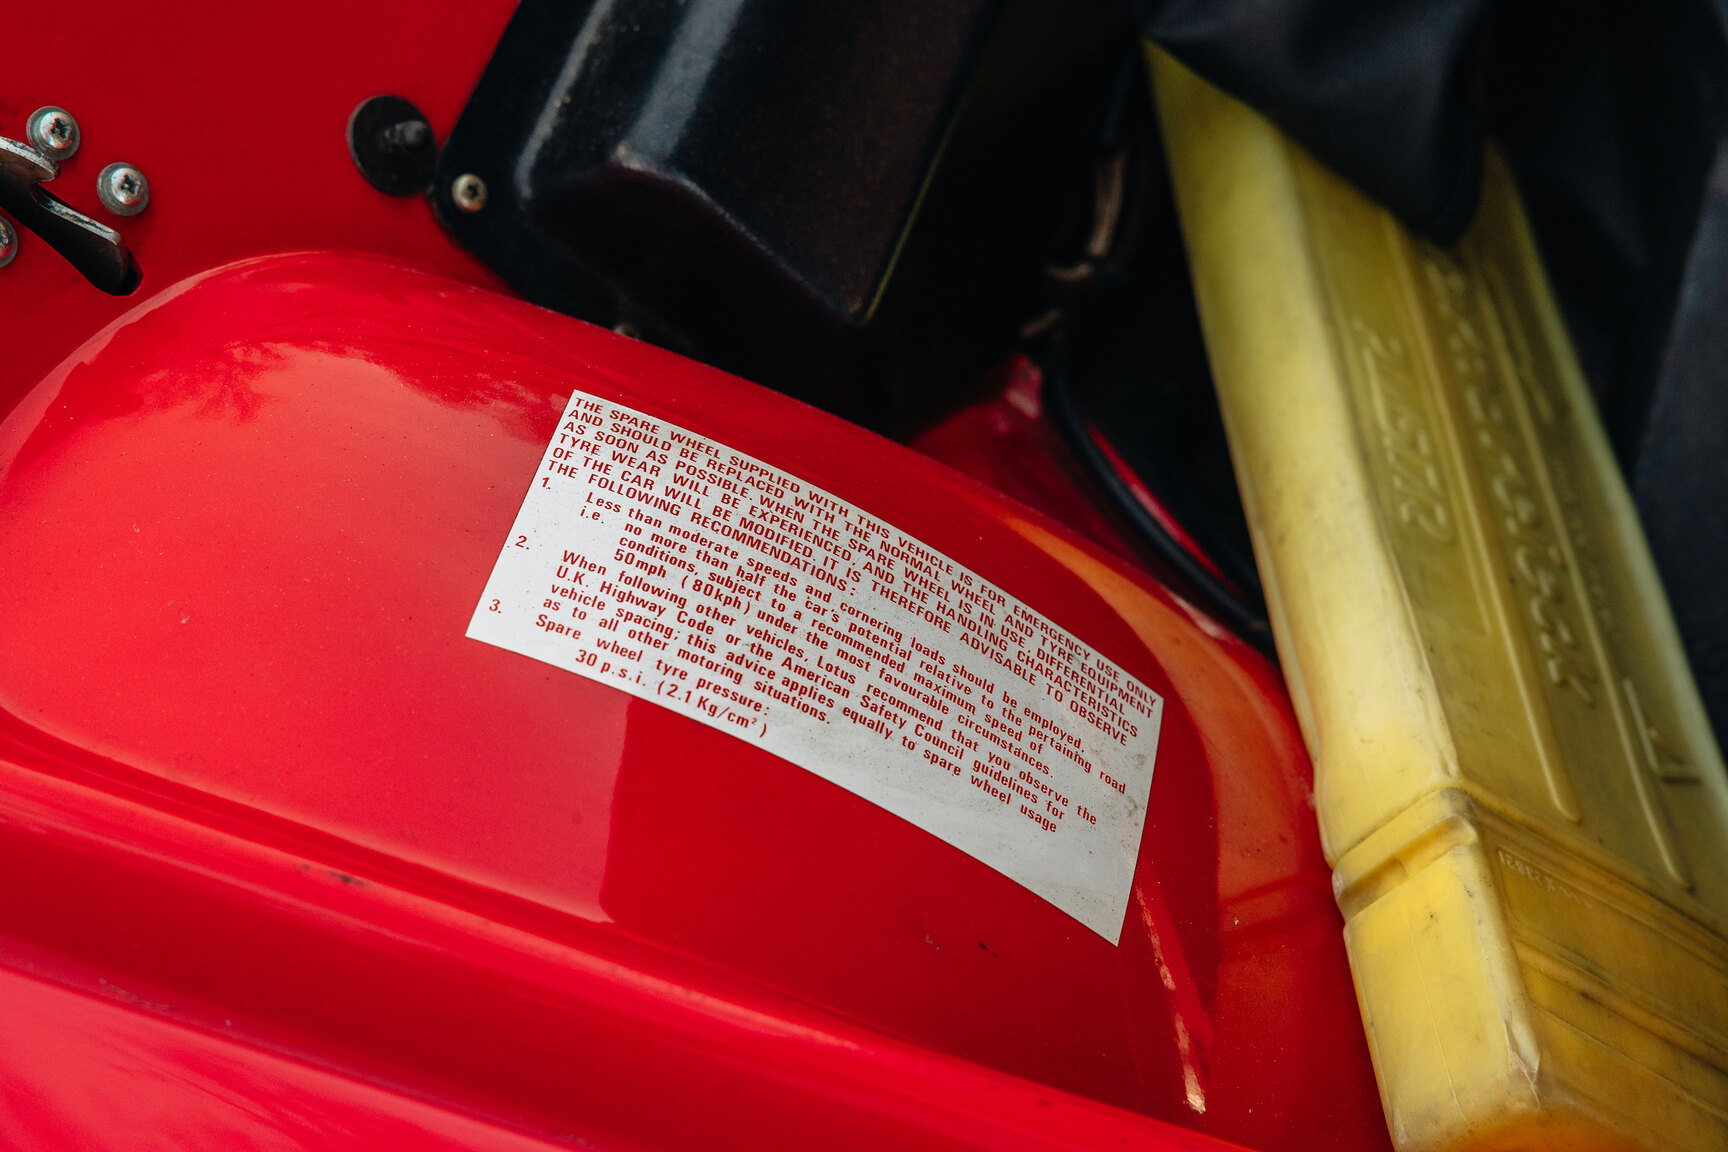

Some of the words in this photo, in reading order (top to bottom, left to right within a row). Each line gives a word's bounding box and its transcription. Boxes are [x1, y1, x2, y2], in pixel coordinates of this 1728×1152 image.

[488, 598, 502, 614] 3.
[535, 613, 582, 640] Spare
[596, 637, 644, 663] wheel
[655, 658, 689, 681] tyre
[695, 677, 770, 716] pressure:
[541, 477, 551, 490] 1.
[586, 491, 622, 513] Less
[628, 508, 663, 529] than
[668, 524, 739, 560] moderate
[746, 557, 798, 587] speeds
[804, 584, 833, 604] and
[839, 602, 904, 646] cornering
[910, 636, 946, 666] loads
[951, 663, 996, 695] should
[1002, 689, 1018, 709] be
[1023, 706, 1085, 753] employed,
[543, 598, 561, 612] as
[571, 606, 588, 621] to
[597, 617, 620, 633] all
[627, 628, 670, 652] other
[676, 647, 744, 686] motoring
[753, 680, 831, 725] situations.
[548, 459, 578, 479] THE
[587, 473, 682, 517] FOLLOWING
[689, 511, 856, 597] RECOMMENDATIONS:
[552, 447, 574, 461] OF
[583, 455, 613, 476] THE
[620, 470, 655, 491] CAR
[664, 485, 701, 510] WILL
[711, 505, 733, 523] BE
[738, 516, 817, 562] MODIFIED.
[823, 555, 839, 571] IT
[845, 567, 862, 583] IS
[872, 579, 951, 634] THEREFORE
[959, 631, 1037, 687] ADVISABLE
[1046, 682, 1065, 703] TO
[1069, 699, 1127, 747] OBSERVE
[559, 432, 601, 455] TYRE
[611, 449, 662, 478] WEAR
[672, 472, 709, 497] WILL
[720, 492, 741, 510] BE
[748, 504, 856, 567] EXPERIENCED,
[862, 561, 896, 585] AND
[903, 580, 929, 605] THE
[935, 600, 1009, 653] HANDLING
[1016, 649, 1138, 738] CHARACTERISTICS
[563, 421, 587, 436] AS
[594, 430, 640, 455] SOON
[645, 449, 669, 465] AS
[674, 459, 753, 501] POSSIBLE.
[759, 494, 805, 524] WHEN
[812, 519, 841, 542] THE
[847, 537, 895, 570] SPARE
[904, 566, 950, 603] WHEEL
[957, 599, 973, 615] IS
[979, 611, 995, 629] IN
[1035, 647, 1124, 715] DIFFERENTIAL
[567, 409, 604, 427] AND
[610, 422, 673, 452] SHOULD
[679, 447, 699, 463] BE
[705, 458, 785, 499] REPLACED
[794, 495, 836, 524] WITH
[844, 519, 872, 543] THE
[879, 539, 941, 583] NORMAL
[951, 579, 996, 616] WHEEL
[1003, 613, 1035, 639] AND
[1040, 634, 1075, 667] TYRE
[1079, 661, 1155, 719] EQUIPMENT
[575, 397, 603, 415] THE
[609, 409, 659, 435] SPARE
[670, 430, 721, 460] WHEEL
[728, 455, 801, 494] SUPPLIED
[808, 490, 849, 518] WITH
[857, 514, 890, 540] THIS
[898, 535, 953, 576] VEHICLE
[959, 571, 973, 587] IS
[979, 583, 1007, 608] FOR
[1012, 604, 1092, 661] EMERGENCY
[1095, 658, 1120, 683] USE
[1125, 679, 1158, 707] ONLY
[579, 505, 605, 524] i.e.
[624, 523, 643, 536] no
[650, 532, 688, 554] more
[695, 549, 729, 572] than
[735, 564, 767, 587] half
[773, 583, 797, 602] the
[804, 596, 841, 624] car's
[847, 621, 913, 662] potential
[919, 659, 972, 696] relative
[980, 693, 995, 710] to
[1001, 706, 1023, 727] the
[1027, 724, 1092, 775] pertaining
[1098, 770, 1127, 795] road
[619, 536, 699, 577] conditions,
[707, 571, 762, 602] subject
[770, 597, 787, 613] to
[792, 609, 803, 622] a
[810, 618, 906, 674] recommended
[913, 672, 977, 716] maximum
[983, 713, 1024, 743] speed
[1028, 740, 1044, 755] of
[514, 535, 530, 551] 2.
[562, 549, 607, 576] When
[617, 570, 688, 610] following
[695, 603, 737, 627] other
[746, 624, 809, 663] vehicles,
[816, 655, 857, 685] Lotus
[866, 683, 944, 732] recommend
[951, 728, 980, 753] that
[987, 751, 1012, 772] you
[1018, 770, 1070, 808] observe
[1076, 805, 1097, 826] the
[551, 583, 606, 611] vehicle
[615, 607, 681, 641] spacing;
[687, 633, 717, 655] this
[725, 651, 777, 681] advice
[780, 676, 835, 709] applies
[841, 706, 894, 741] equally
[901, 735, 916, 751] to
[922, 748, 962, 777] spare
[970, 774, 1012, 806] wheel
[1019, 803, 1057, 833] usage
[556, 564, 589, 588] U.K.
[599, 580, 667, 618] Highway
[676, 610, 715, 636] Code
[725, 633, 742, 646] or
[749, 642, 774, 662] the
[780, 656, 851, 699] American
[859, 693, 907, 730] Safety
[913, 723, 965, 761] Council
[971, 759, 1039, 805] guidelines
[1045, 800, 1065, 821] for
[756, 609, 799, 635] under
[805, 631, 829, 651] the
[836, 647, 871, 673] most
[878, 667, 950, 715] favourable
[956, 714, 1054, 779] circumstances.
